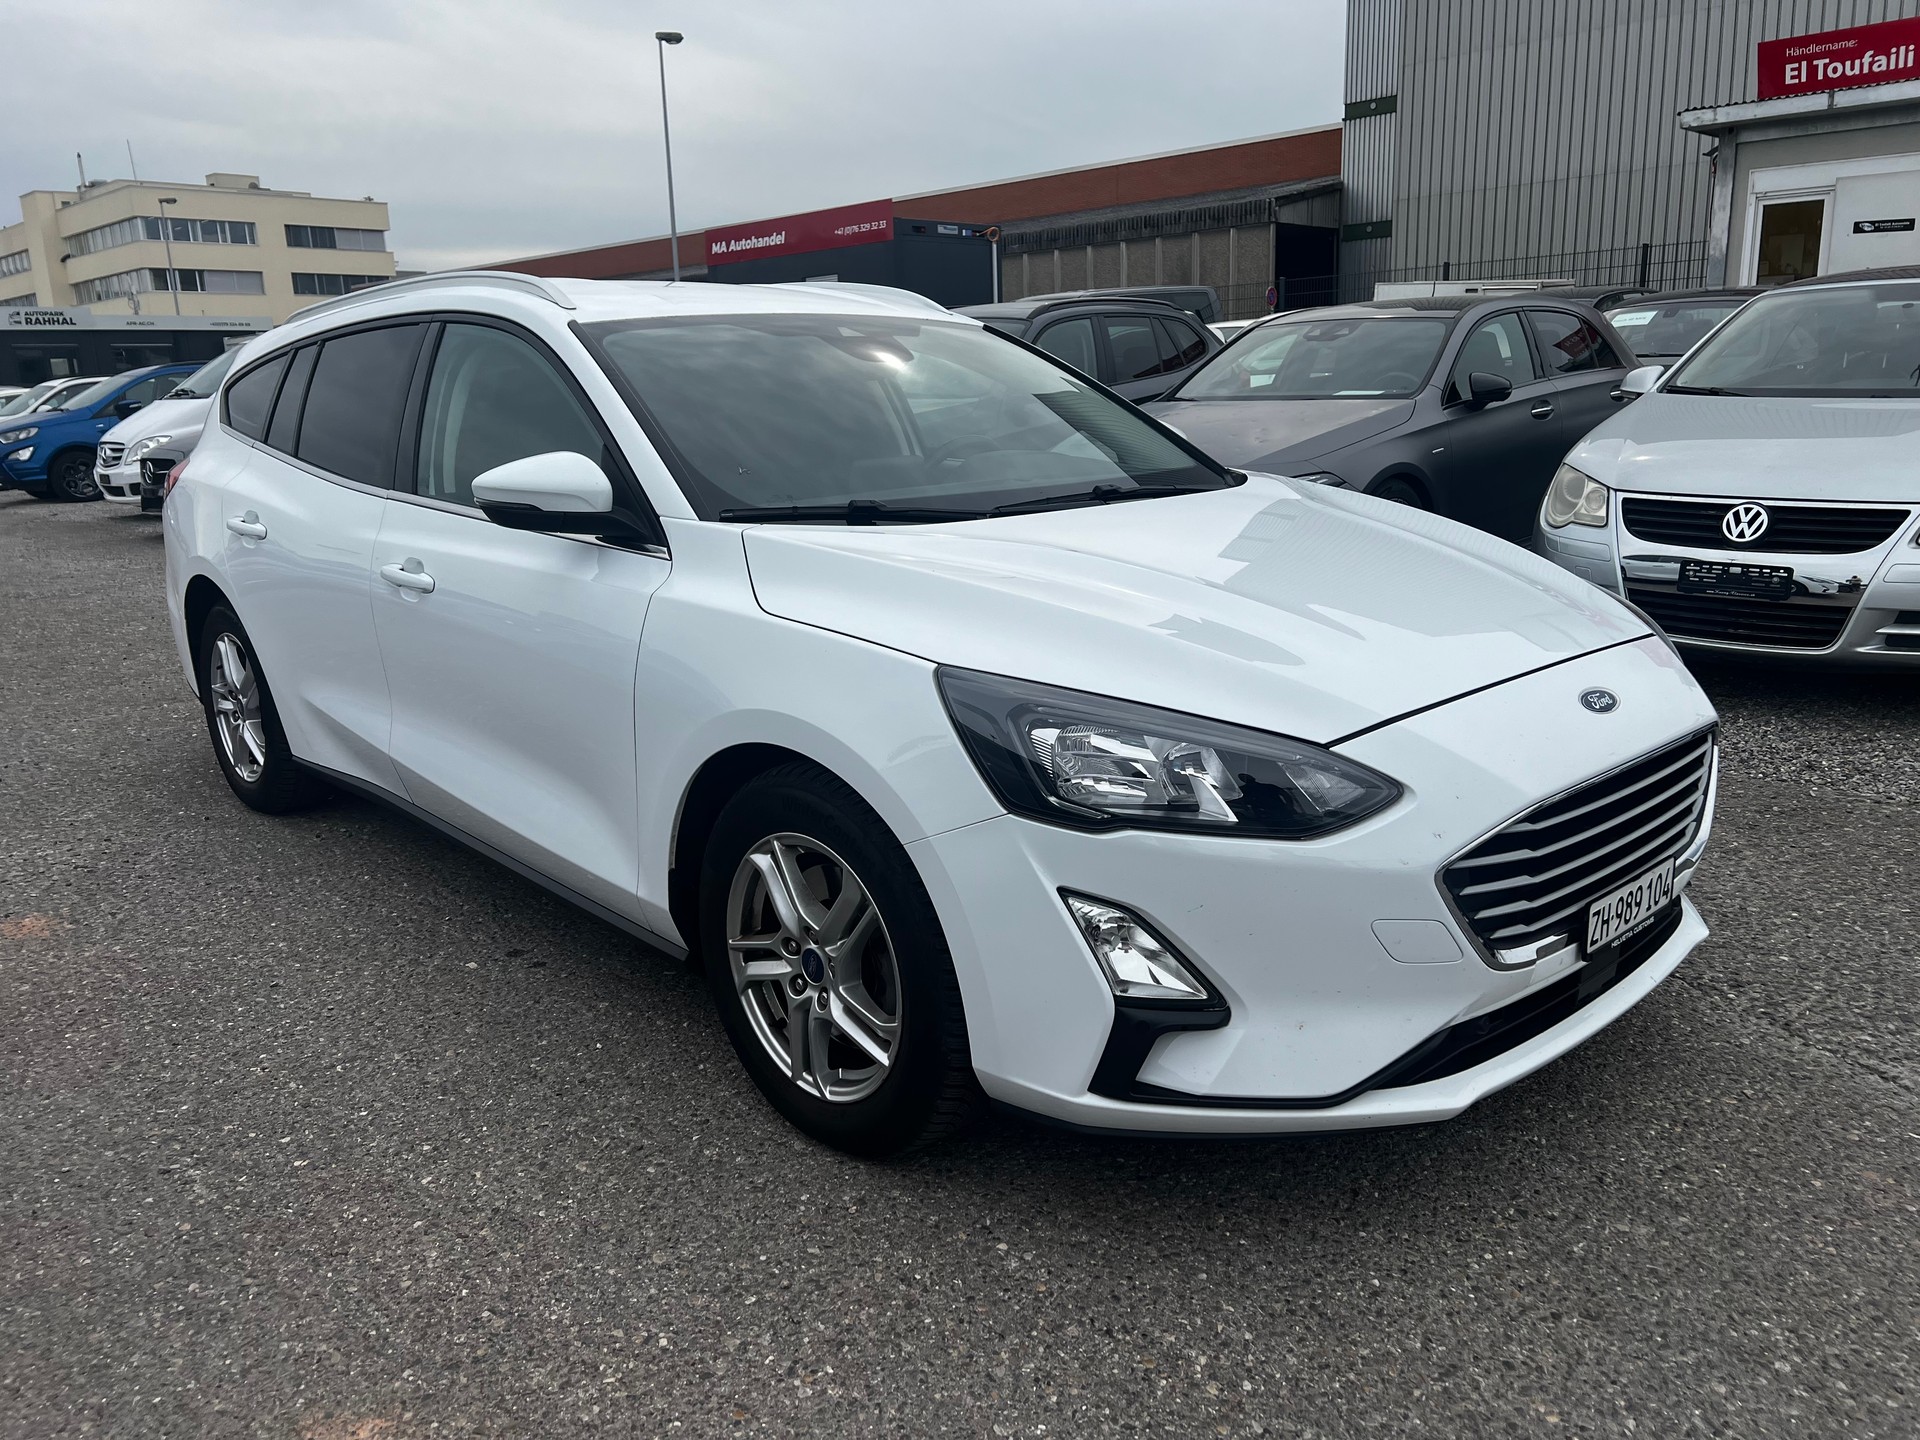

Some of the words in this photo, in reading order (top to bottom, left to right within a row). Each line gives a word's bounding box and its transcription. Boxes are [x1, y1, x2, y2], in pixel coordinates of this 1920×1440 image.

[1786, 39, 1858, 57] Händlername:
[1785, 60, 1807, 85] El
[1812, 44, 1915, 81] Toufaili
[859, 222, 870, 232] 329
[871, 221, 879, 230] 32
[879, 220, 887, 229] 33
[711, 241, 727, 254] MA
[728, 230, 785, 252] Autohandel
[24, 317, 77, 326] RAHHAL
[1724, 505, 1767, 541] VW
[1587, 692, 1613, 710] Ford
[1645, 867, 1671, 913] 104
